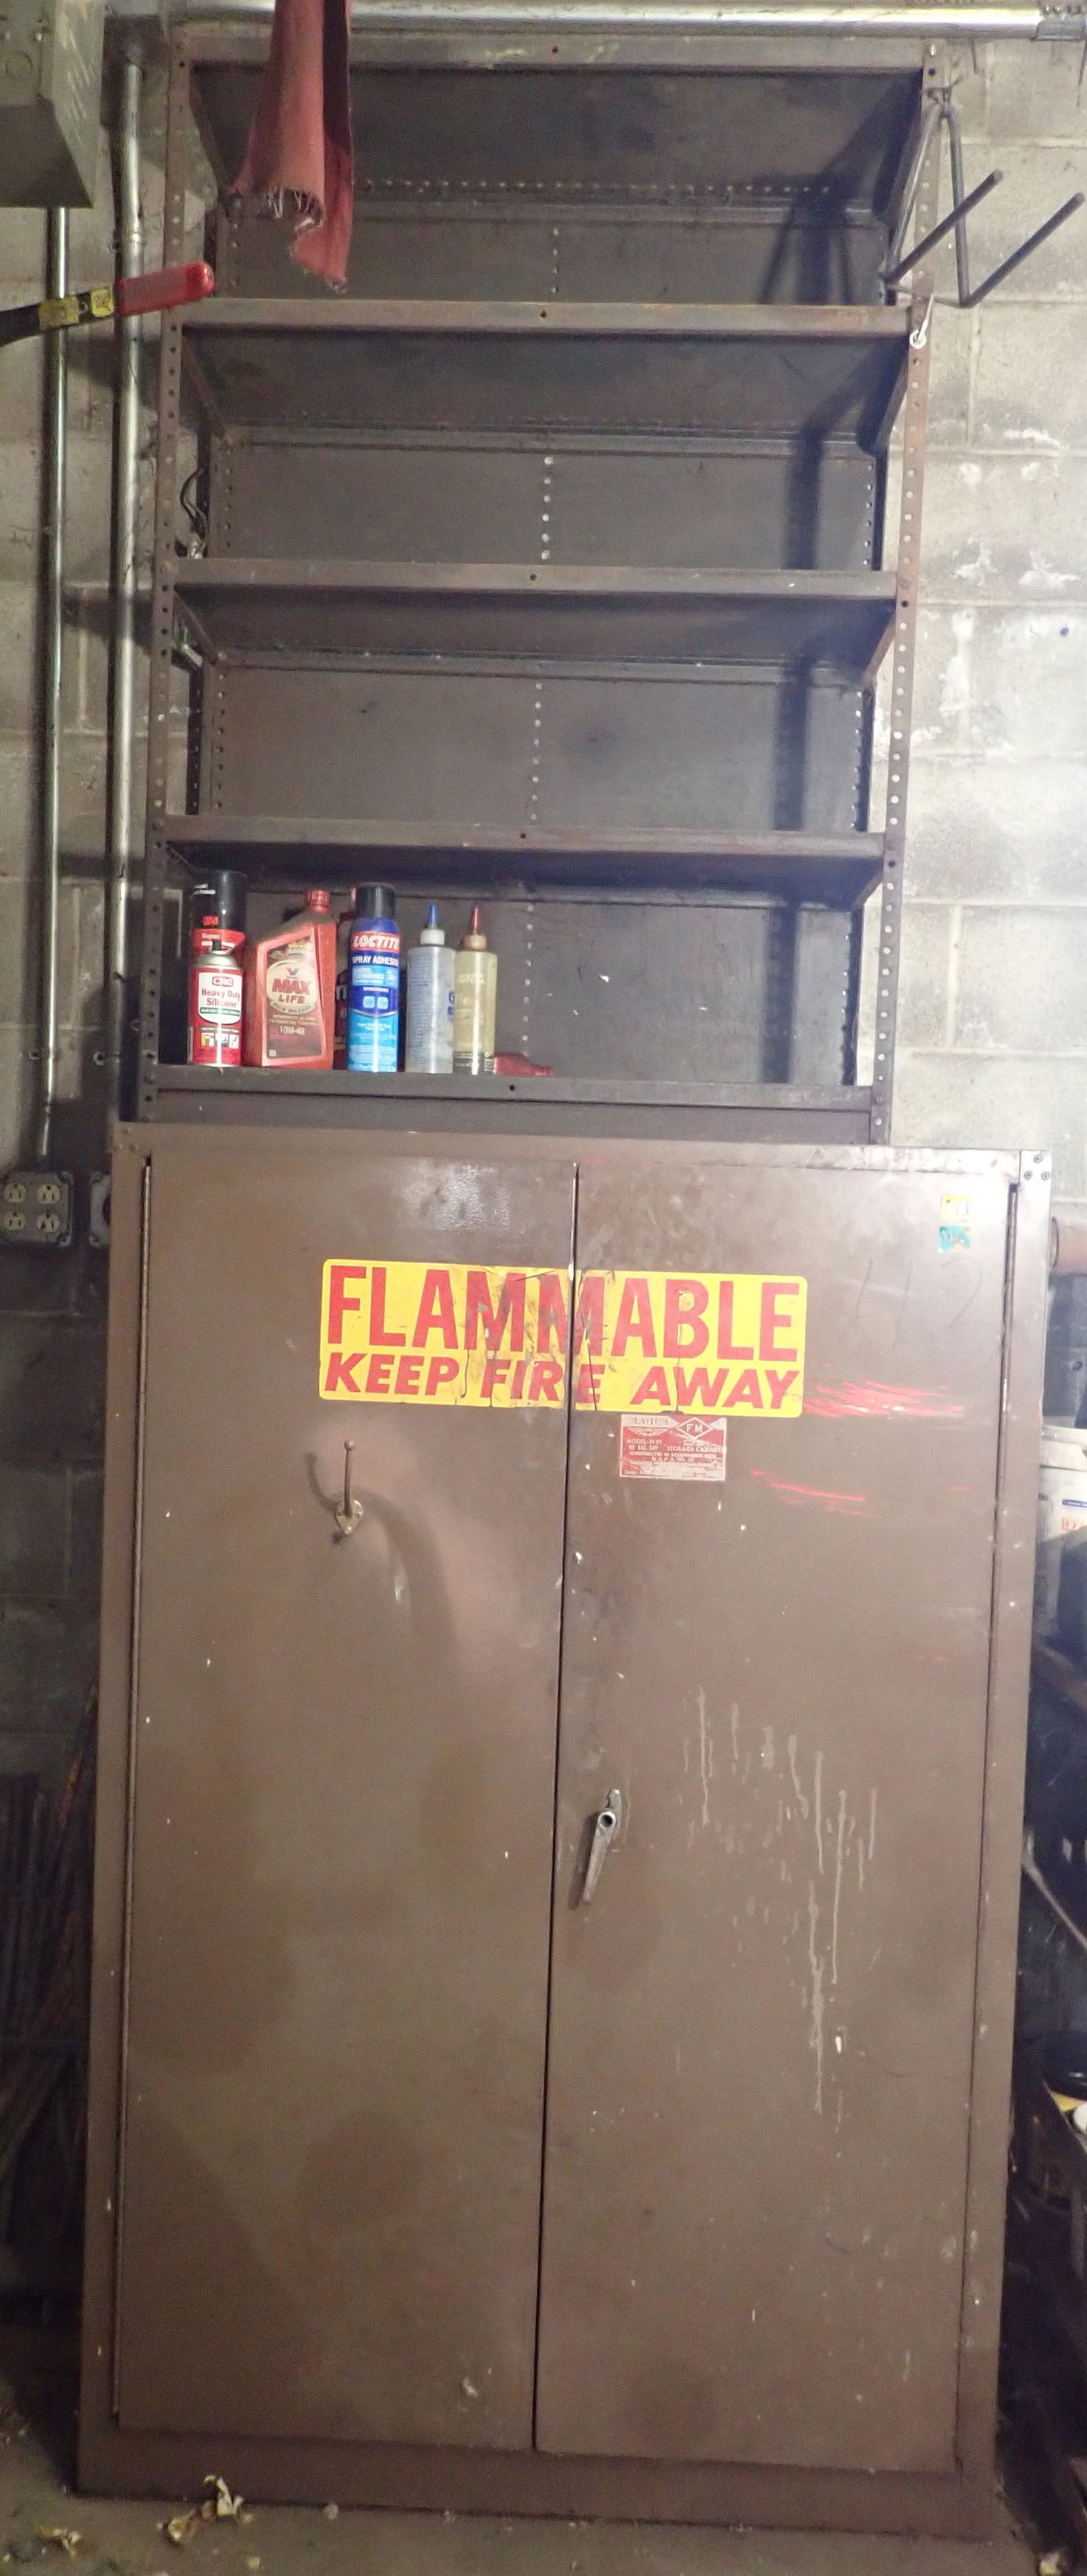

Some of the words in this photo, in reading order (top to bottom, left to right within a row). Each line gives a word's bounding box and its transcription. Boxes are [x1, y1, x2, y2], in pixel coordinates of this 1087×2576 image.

[353, 935, 399, 949] LOCTITE
[352, 956, 372, 964] SPRAY
[272, 978, 310, 995] MAX
[202, 988, 225, 998] Heavy
[207, 998, 237, 1007] Silicone
[279, 994, 305, 1004] LIFE
[279, 1026, 305, 1035] 10W-40
[327, 1265, 800, 1364] FLAMMABLE
[324, 1351, 461, 1396] KEEP
[480, 1360, 605, 1404] FIRE
[629, 1365, 800, 1411] AWAY
